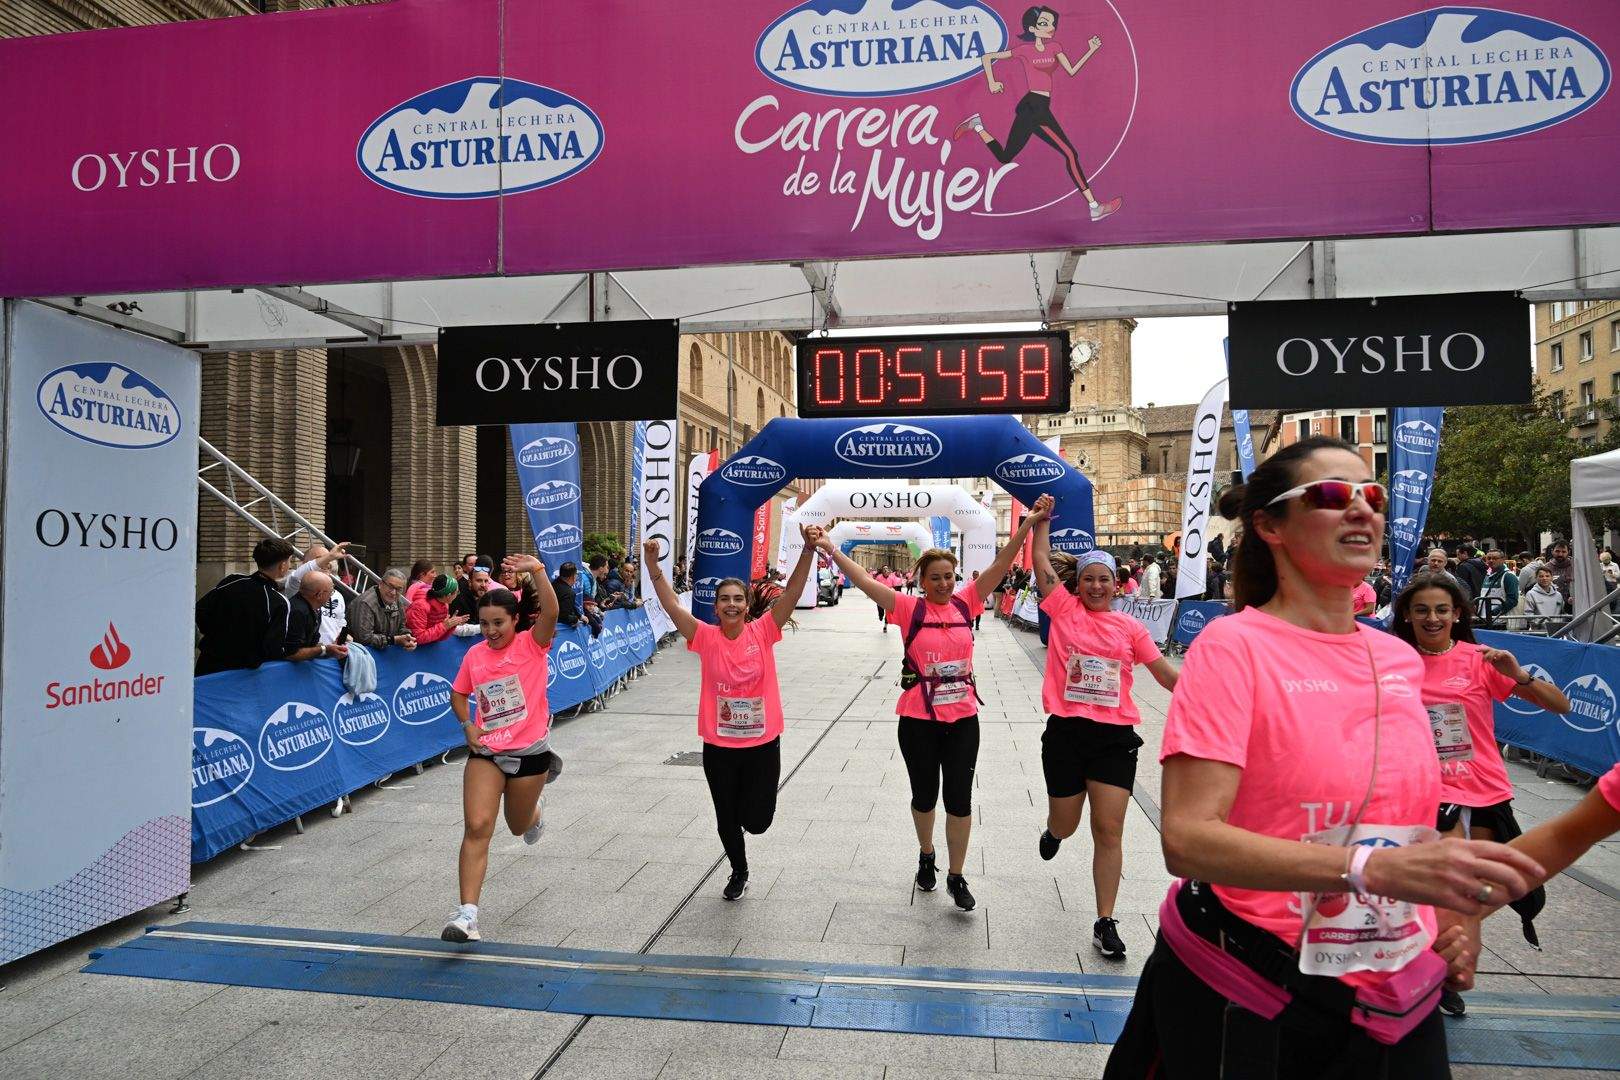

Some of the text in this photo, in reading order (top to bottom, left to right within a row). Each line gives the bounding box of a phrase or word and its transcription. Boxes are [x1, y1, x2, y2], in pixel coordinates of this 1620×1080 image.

[812, 14, 980, 35] CENTRAL LECHERA
[774, 29, 987, 71] ASTURIANA
[1362, 47, 1574, 73] CENTRAL LECHERA
[1314, 66, 1586, 116] ASTURIANA
[413, 113, 576, 135] CENTRAL LECHERA
[734, 95, 939, 153] Carrera
[71, 143, 241, 192] OYSHO
[375, 128, 584, 172] ASTURIANA
[782, 139, 1019, 240] de la Mujer
[1276, 332, 1486, 377] OYSHO
[475, 354, 643, 392] OYSHO
[49, 382, 172, 434] ASTURIANA
[73, 385, 121, 402] CENTRAL
[843, 438, 934, 456] ASTURIANA
[725, 466, 781, 479] ASTURIANA
[1001, 466, 1061, 478] ASTURIANA
[1184, 413, 1217, 559] OYSHO
[645, 420, 671, 562] OYSHO
[850, 492, 932, 508] OYSHO
[36, 509, 178, 551] OYSHO
[925, 651, 941, 663] TU
[46, 673, 164, 709] Santander
[398, 688, 452, 717] ASTURIANA
[339, 708, 388, 736] ASTURIANA
[267, 724, 332, 761] ASTURIANA
[1300, 800, 1351, 835] TU
